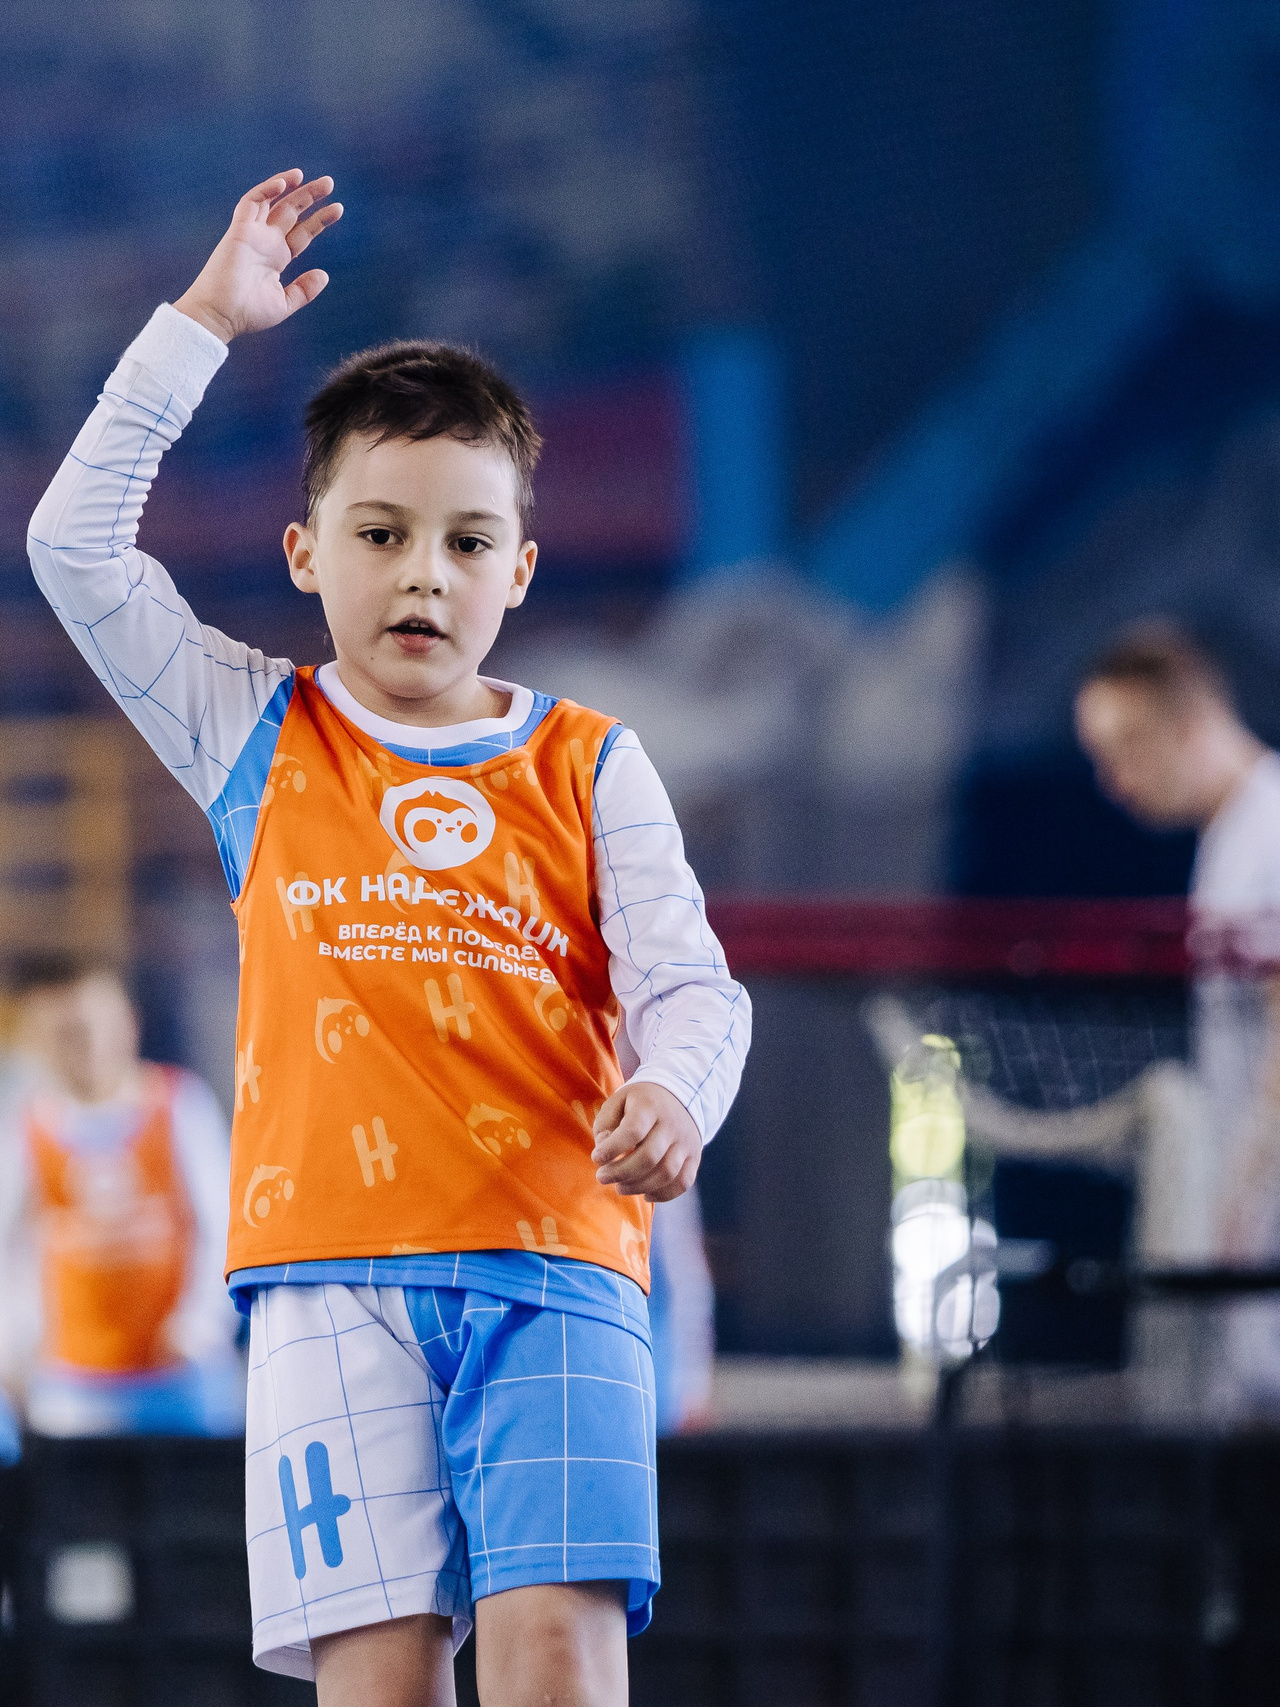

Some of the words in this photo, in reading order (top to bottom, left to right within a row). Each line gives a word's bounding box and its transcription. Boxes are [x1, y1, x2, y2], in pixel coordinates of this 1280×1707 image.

[286, 876, 348, 906] ФК
[337, 921, 422, 944] ВПЕРЁД
[426, 925, 442, 942] К
[317, 941, 406, 961] ВМЕСТЕ
[411, 947, 448, 963] МЫ
[453, 950, 558, 986] СИЛЬНЕЕ!
